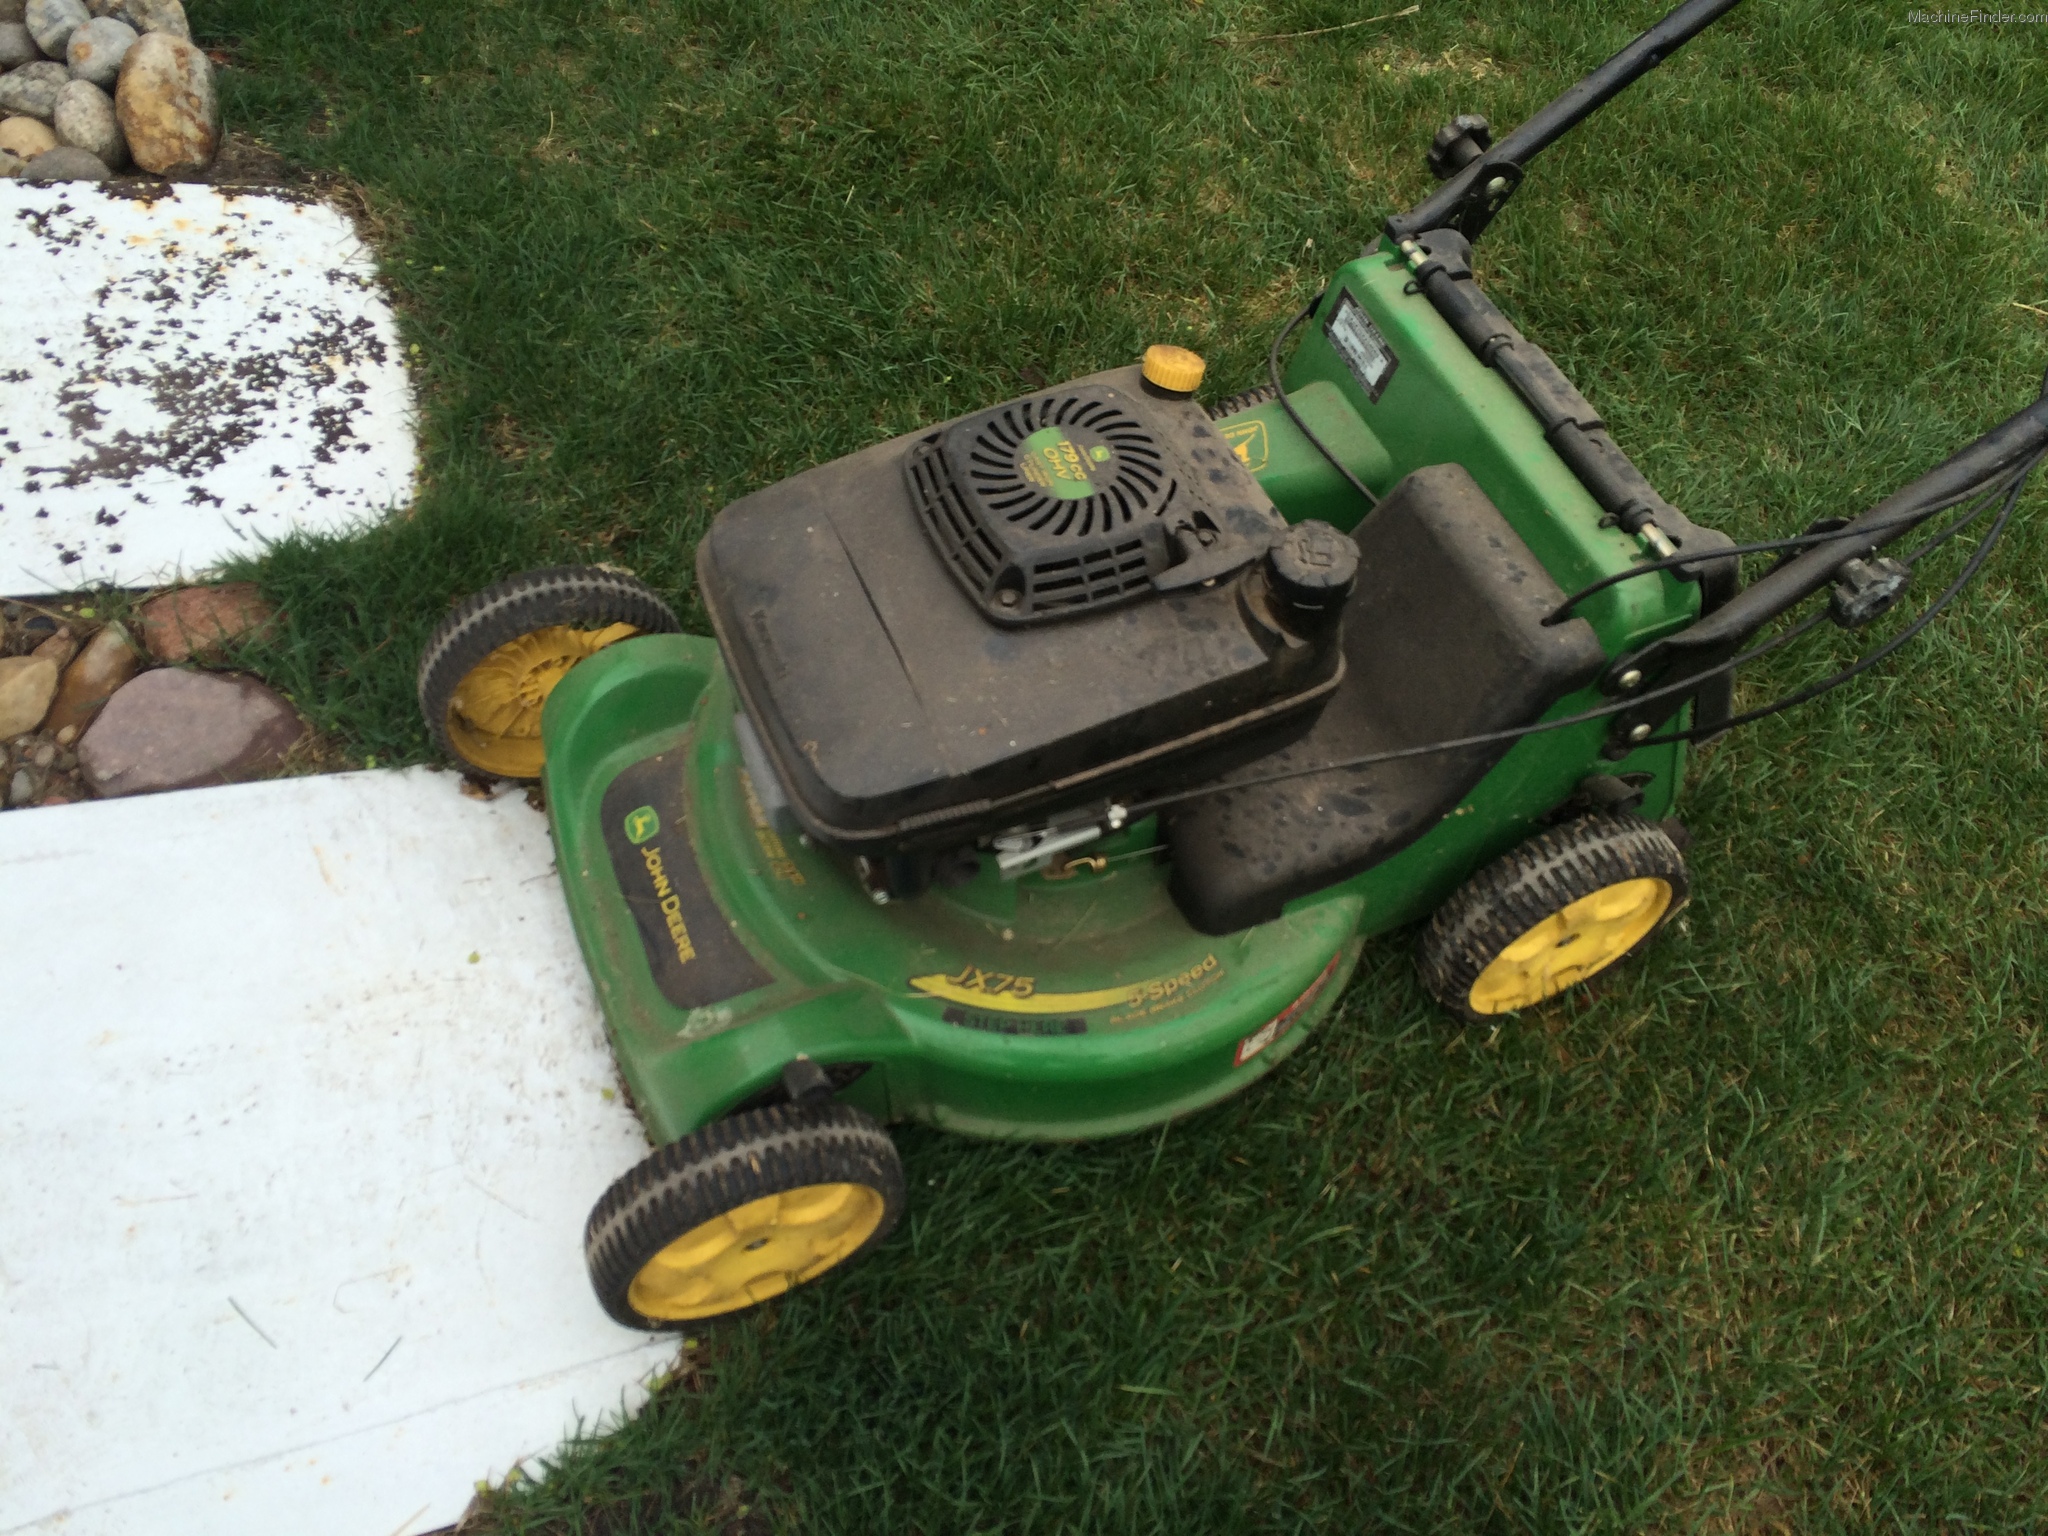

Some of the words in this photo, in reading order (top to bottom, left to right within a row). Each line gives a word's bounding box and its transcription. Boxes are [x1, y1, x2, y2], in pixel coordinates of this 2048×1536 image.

[1043, 447, 1071, 480] OHV
[640, 846, 672, 898] JOHN
[660, 894, 696, 964] DEERE
[946, 964, 1035, 999] JX75
